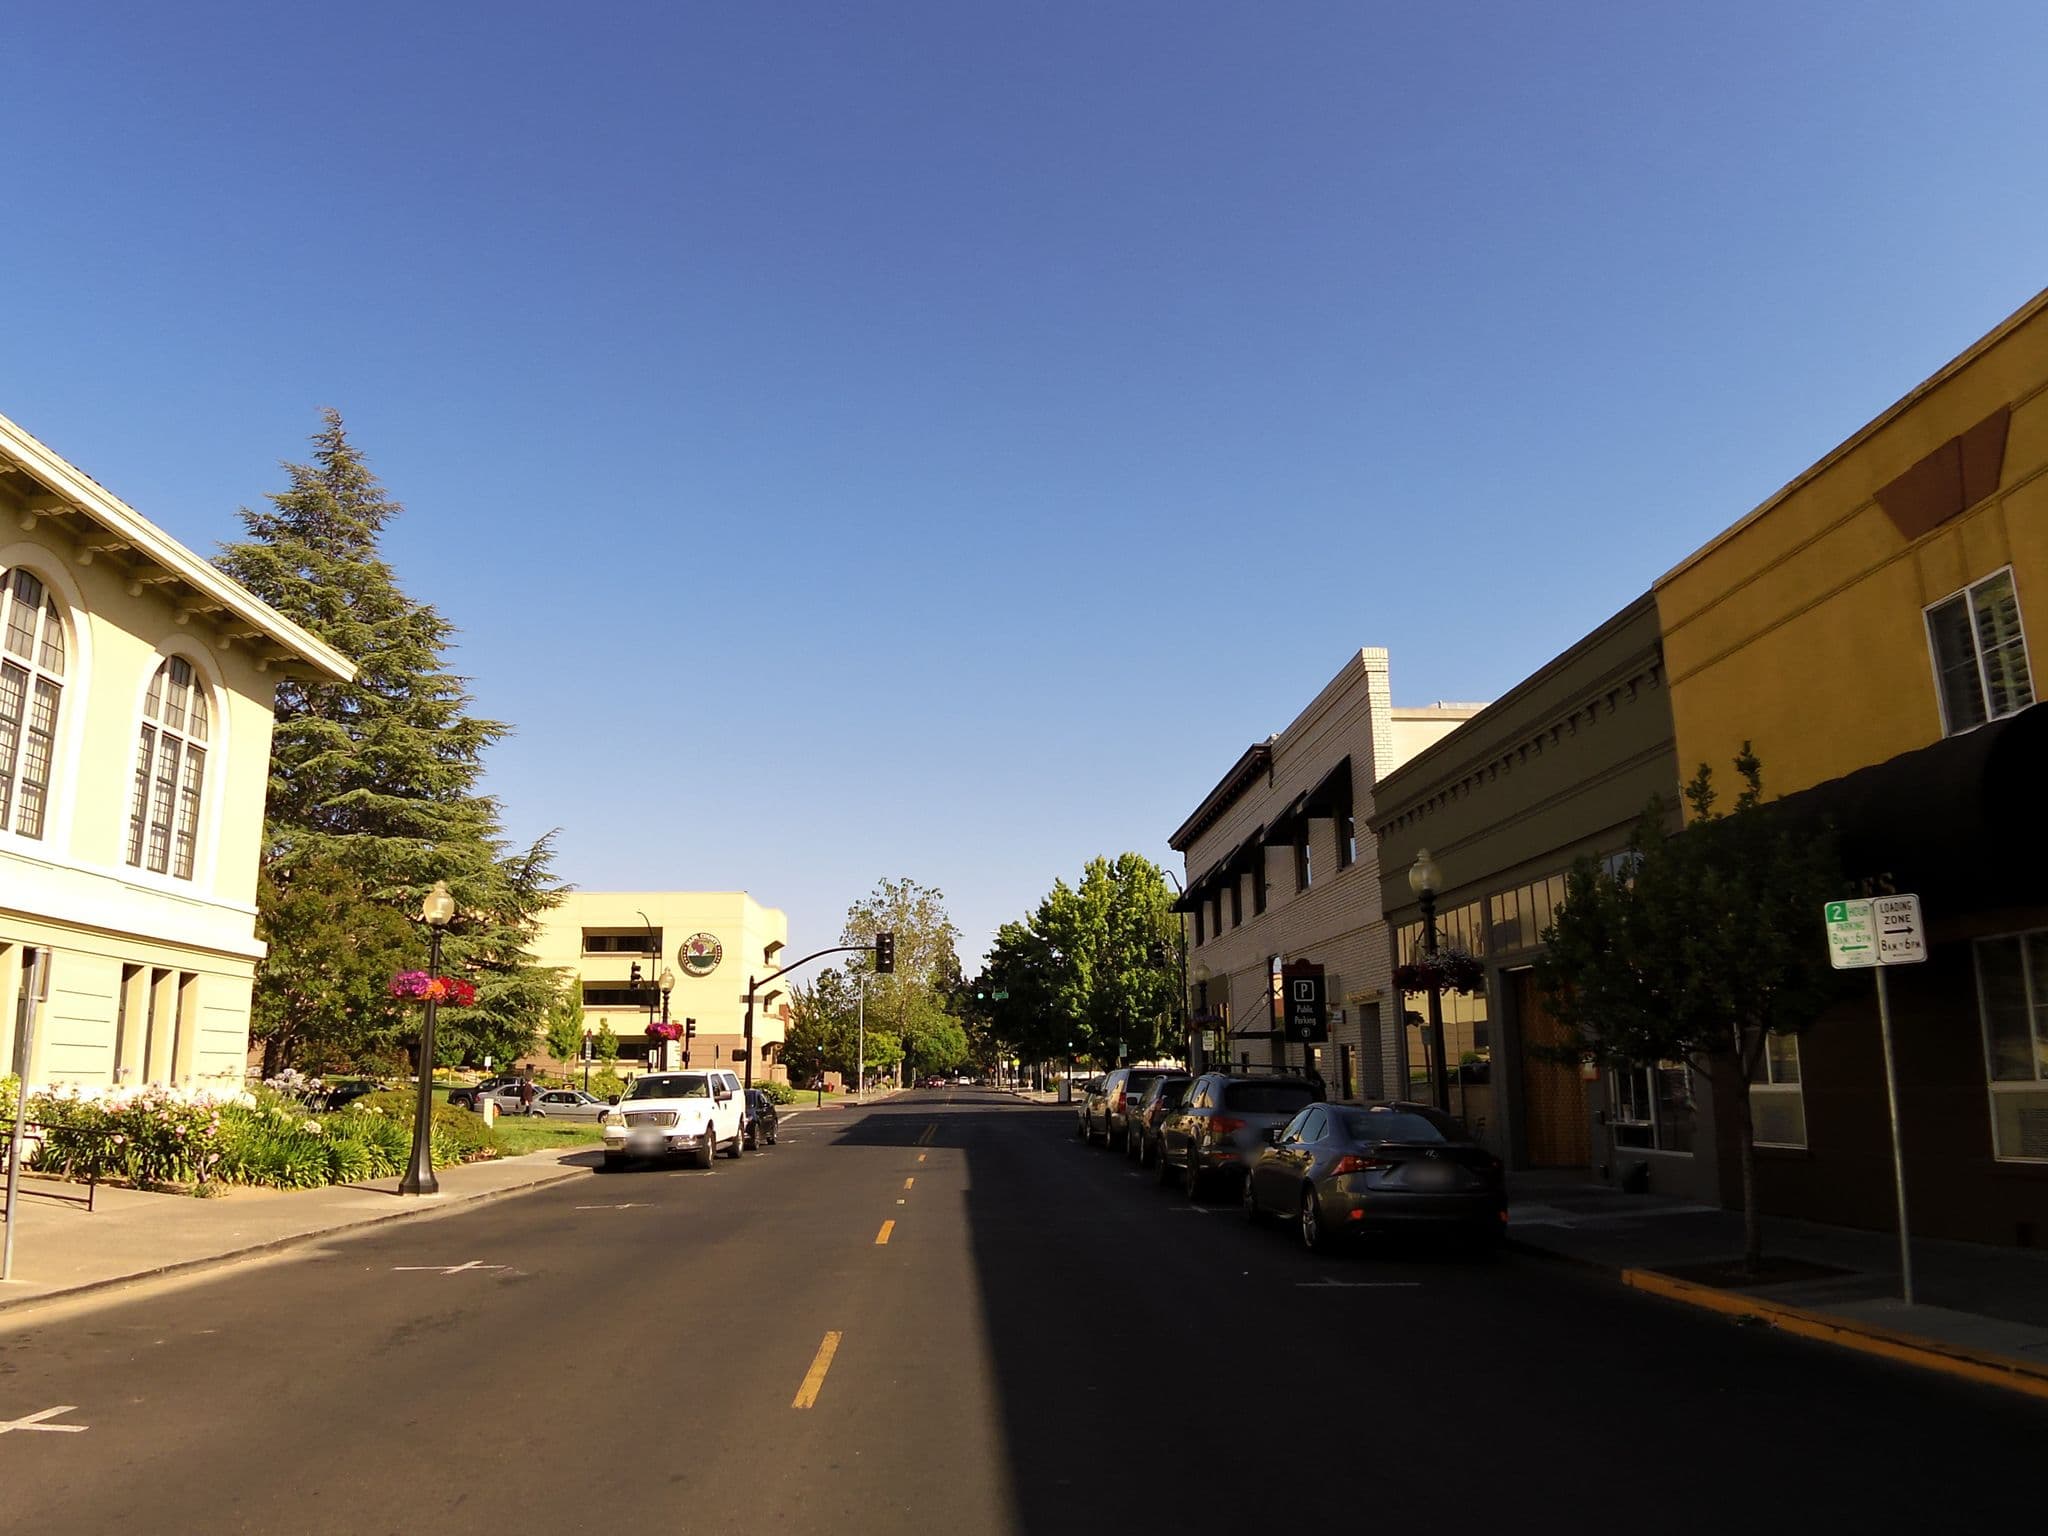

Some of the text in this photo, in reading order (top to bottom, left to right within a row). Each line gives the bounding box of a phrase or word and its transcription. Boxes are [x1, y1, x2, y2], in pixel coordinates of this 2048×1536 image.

[1832, 906, 1843, 920] 2
[1879, 900, 1912, 914] LOADING
[1884, 914, 1911, 925] ZONE
[1300, 983, 1308, 999] P
[1294, 1016, 1317, 1026] Parking
